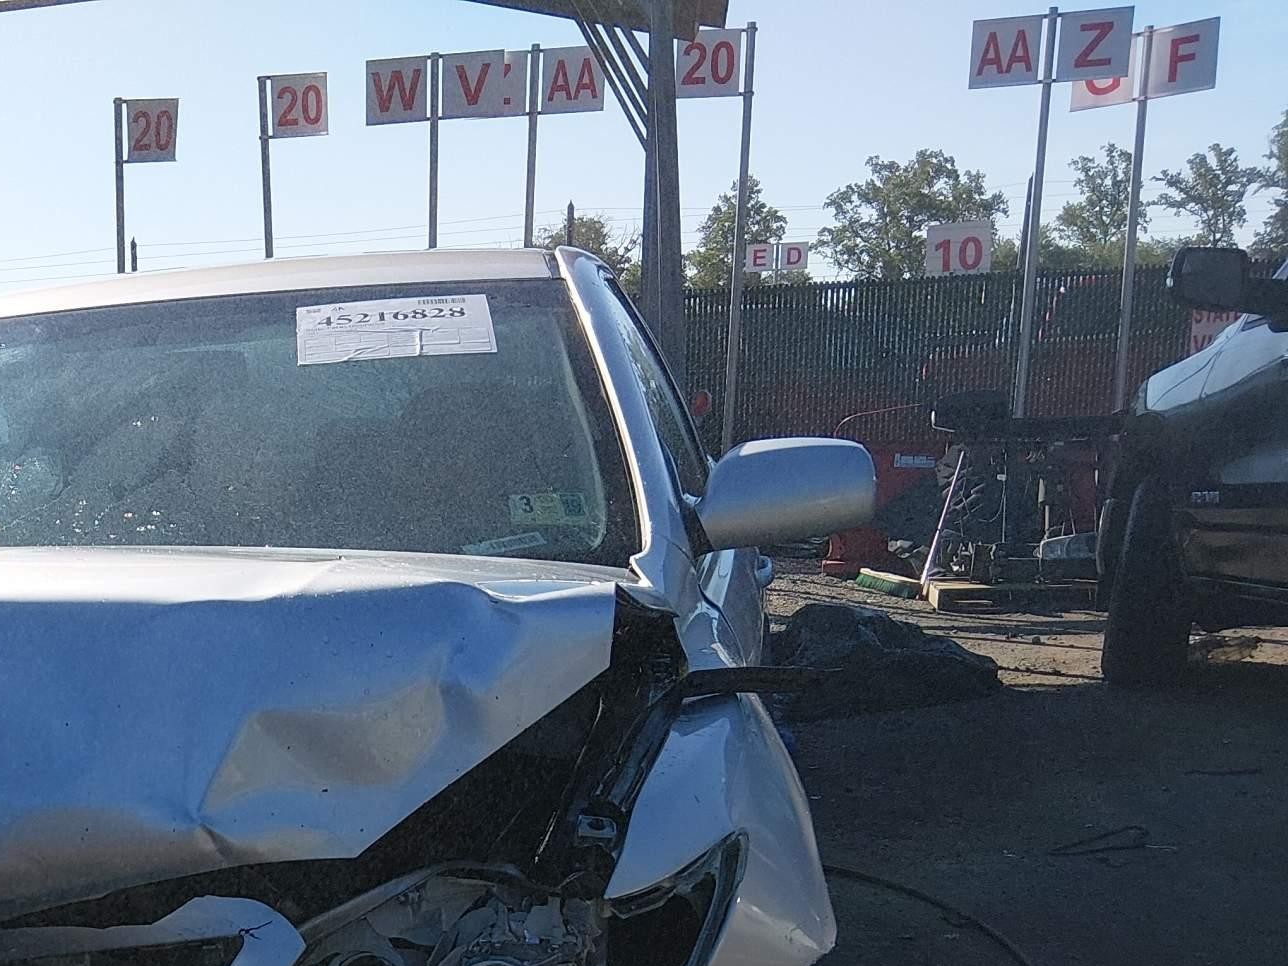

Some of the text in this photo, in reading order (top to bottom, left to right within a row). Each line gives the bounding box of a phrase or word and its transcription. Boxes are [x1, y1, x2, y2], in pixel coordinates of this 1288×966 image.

[682, 40, 736, 86] 20
[975, 30, 1034, 77] AA
[1073, 21, 1115, 69] Z
[1167, 34, 1200, 83] F
[371, 67, 422, 114] W
[454, 63, 490, 107] V
[546, 56, 600, 103] AA
[277, 82, 325, 128] 20
[132, 109, 174, 153] 20
[752, 247, 767, 268] E
[786, 246, 802, 266] D
[935, 236, 984, 272] 10
[317, 306, 467, 328] 45216828
